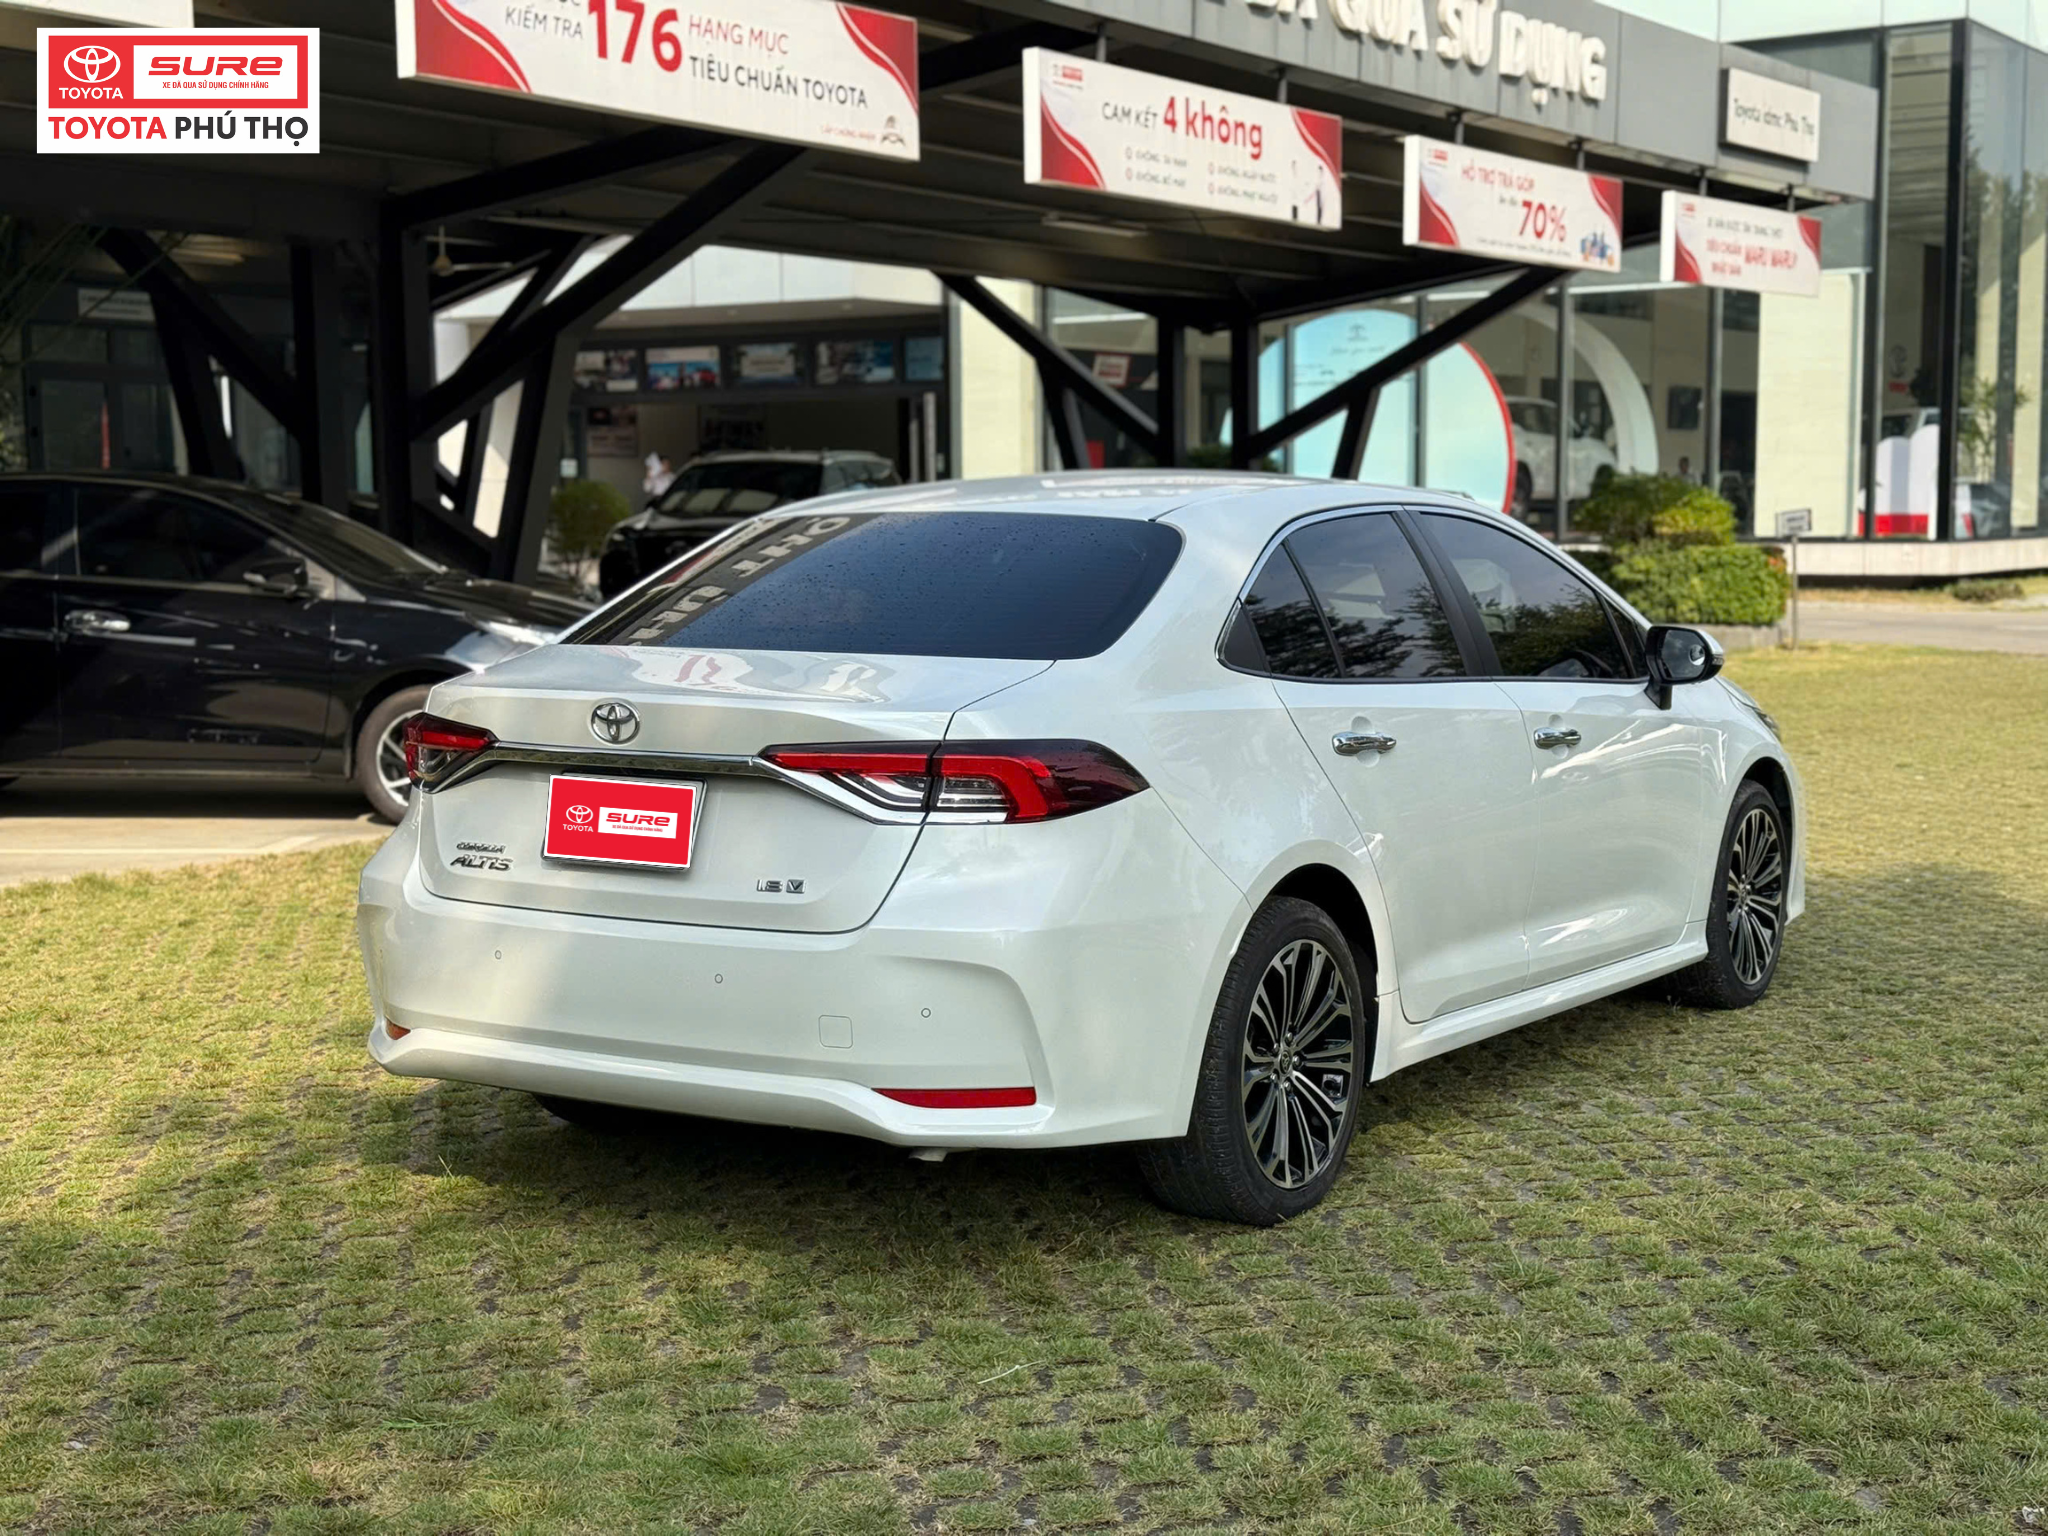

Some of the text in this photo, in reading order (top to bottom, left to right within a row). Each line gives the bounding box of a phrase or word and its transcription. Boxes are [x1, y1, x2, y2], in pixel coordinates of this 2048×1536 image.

[553, 16, 584, 40] TRA
[588, 0, 683, 73] 176
[688, 14, 789, 58] HẠNG MỤC
[1499, 10, 1607, 105] DỤNG
[689, 54, 730, 83] TIÊU
[802, 78, 868, 108] TOYOTA
[1101, 96, 1263, 160] CAM KẾT 4 không
[1733, 97, 1761, 125] Toyota
[1518, 199, 1567, 243] 70%
[450, 854, 514, 872] ALTIS
[786, 879, 805, 894] V
